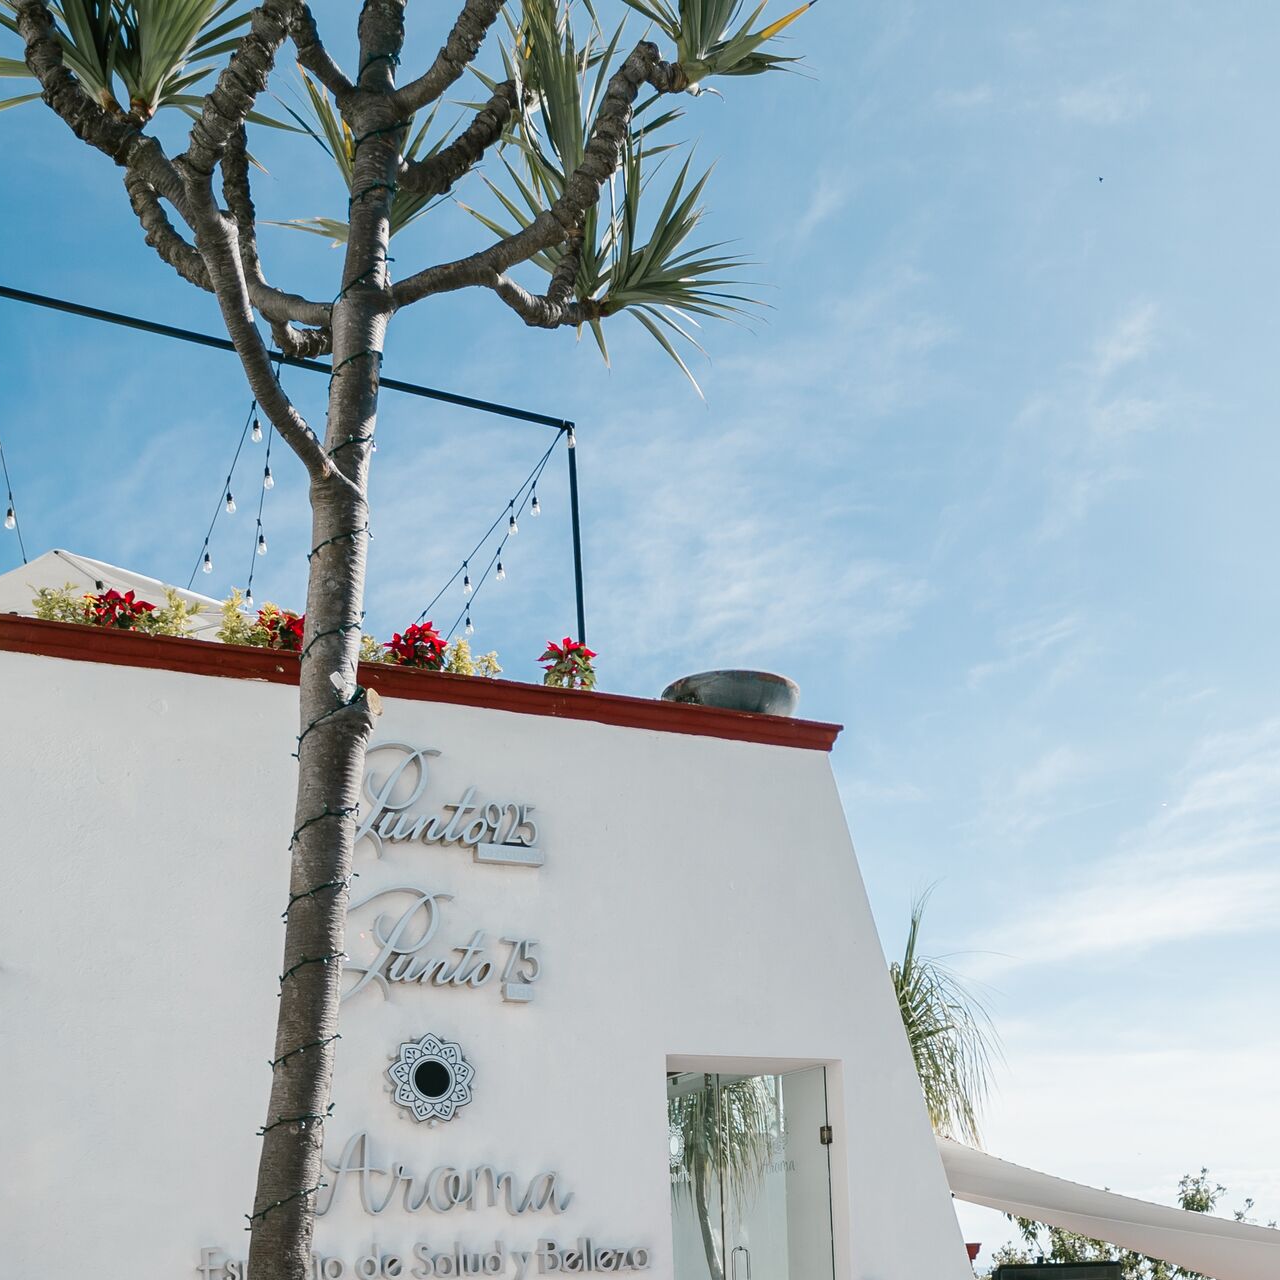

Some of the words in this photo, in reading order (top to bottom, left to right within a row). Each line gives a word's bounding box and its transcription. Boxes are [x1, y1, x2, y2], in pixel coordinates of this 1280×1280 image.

[353, 742, 488, 859] Punto
[483, 801, 539, 847] 925
[340, 884, 496, 1001] Punto
[500, 936, 542, 984] 75
[314, 1130, 575, 1217] Aroma
[355, 1242, 404, 1280] de
[410, 1239, 507, 1280] Salud
[535, 1236, 652, 1275] Belleza
